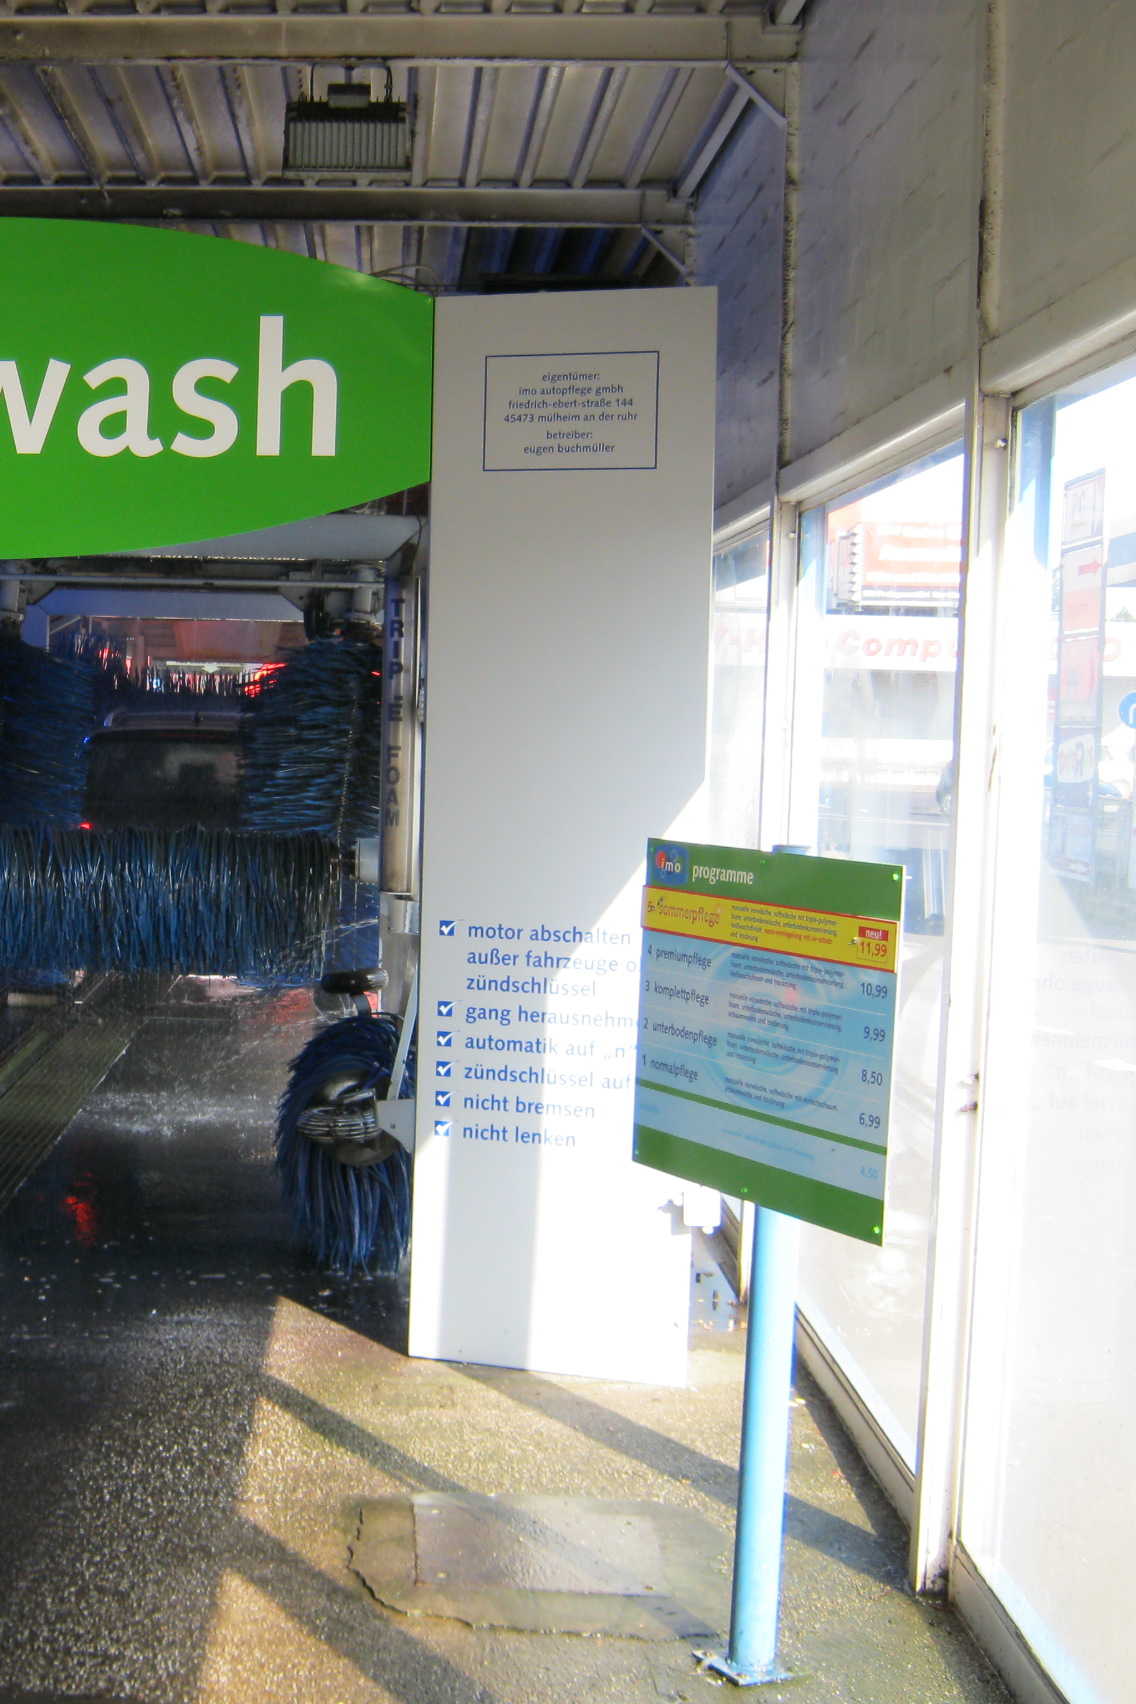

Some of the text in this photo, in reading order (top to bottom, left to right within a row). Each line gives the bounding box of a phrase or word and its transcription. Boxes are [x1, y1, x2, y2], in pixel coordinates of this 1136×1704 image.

[542, 372, 600, 384] eigentümer:
[519, 384, 623, 397] imo autopflege gmbh
[508, 398, 633, 410] friedrich-ebert-straße 144
[504, 411, 638, 423] 45473 mülheim an der ruhr
[546, 430, 592, 440] betreiber:
[524, 443, 615, 456] eugen buchmüller
[385, 746, 402, 827] FOAM
[660, 857, 754, 885] imo programme
[468, 923, 631, 945] motor abschalten
[865, 929, 882, 940] neu!
[647, 944, 712, 970] 4 premiumpflege
[860, 941, 887, 957] 11,99
[467, 948, 519, 967] außer
[525, 950, 618, 976] fahrzeuge
[466, 974, 596, 997] zündschlüssel
[645, 980, 709, 1007] 3 komplettpflege
[860, 982, 888, 999] 10,99
[465, 1005, 511, 1026] gang
[643, 1017, 717, 1048] 2 unterbodenpflege
[864, 1026, 886, 1042] 9,99
[465, 1036, 558, 1055] automatik
[565, 1040, 596, 1058] auf
[464, 1063, 632, 1090] zündschlüssel auf
[642, 1054, 698, 1083] 1 normalpflege
[861, 1069, 883, 1086] 8,50
[463, 1094, 595, 1118] nicht bremsen
[859, 1112, 880, 1129] 6,99
[463, 1124, 576, 1147] nicht lenken
[860, 1165, 878, 1180] 4,50
